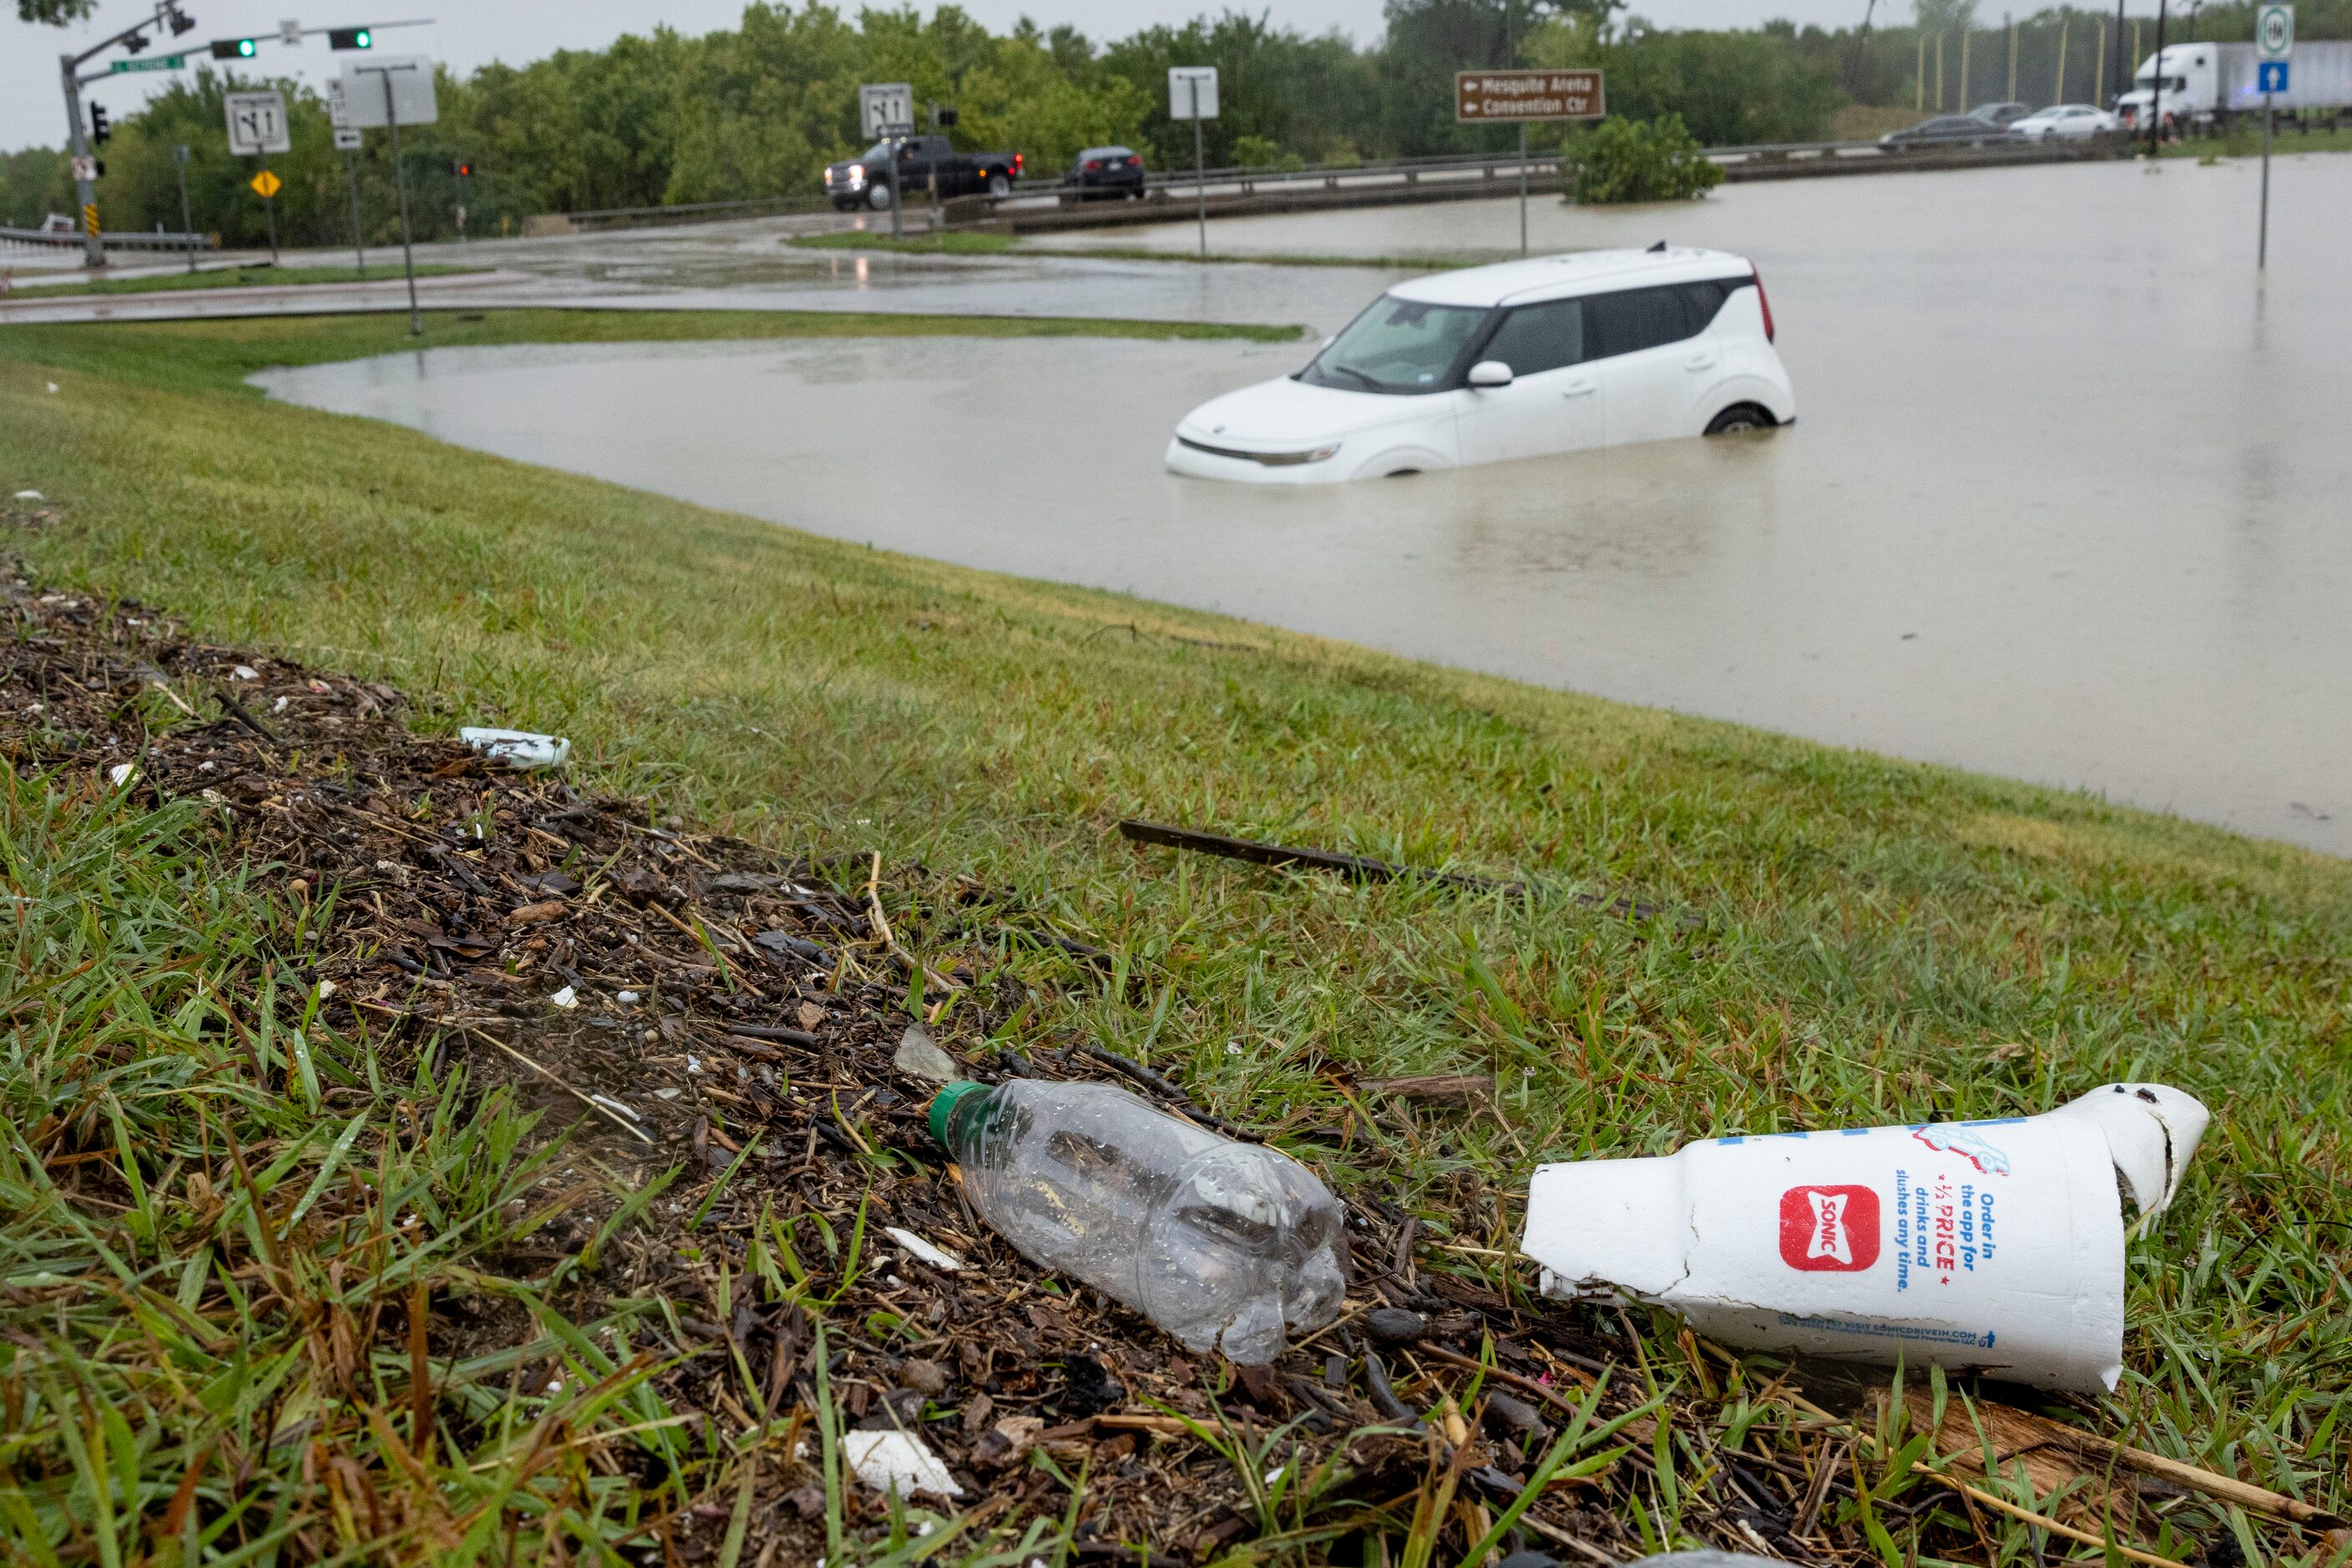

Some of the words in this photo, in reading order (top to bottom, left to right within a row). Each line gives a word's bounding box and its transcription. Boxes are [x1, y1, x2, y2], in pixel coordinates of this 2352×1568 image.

[1482, 78, 1545, 96] Mesquite
[1550, 77, 1592, 94] Arena
[1482, 98, 1562, 114] Convention
[1566, 96, 1587, 113] Ctr
[1896, 1170, 1910, 1216] slushes
[1961, 1185, 1975, 1207] the
[1915, 1187, 1930, 1232] drinks
[1980, 1193, 1995, 1240] Order
[1821, 1199, 1836, 1252] SONIC
[1894, 1219, 1908, 1248] any
[1935, 1205, 1955, 1271] PRICE
[1960, 1211, 1974, 1242] app
[1917, 1235, 1930, 1267] and
[1960, 1245, 1977, 1272] for
[1982, 1242, 1996, 1259] in
[1897, 1252, 1912, 1292] time.
[1873, 1323, 1976, 1340] SONICDRIVEIN.COM
